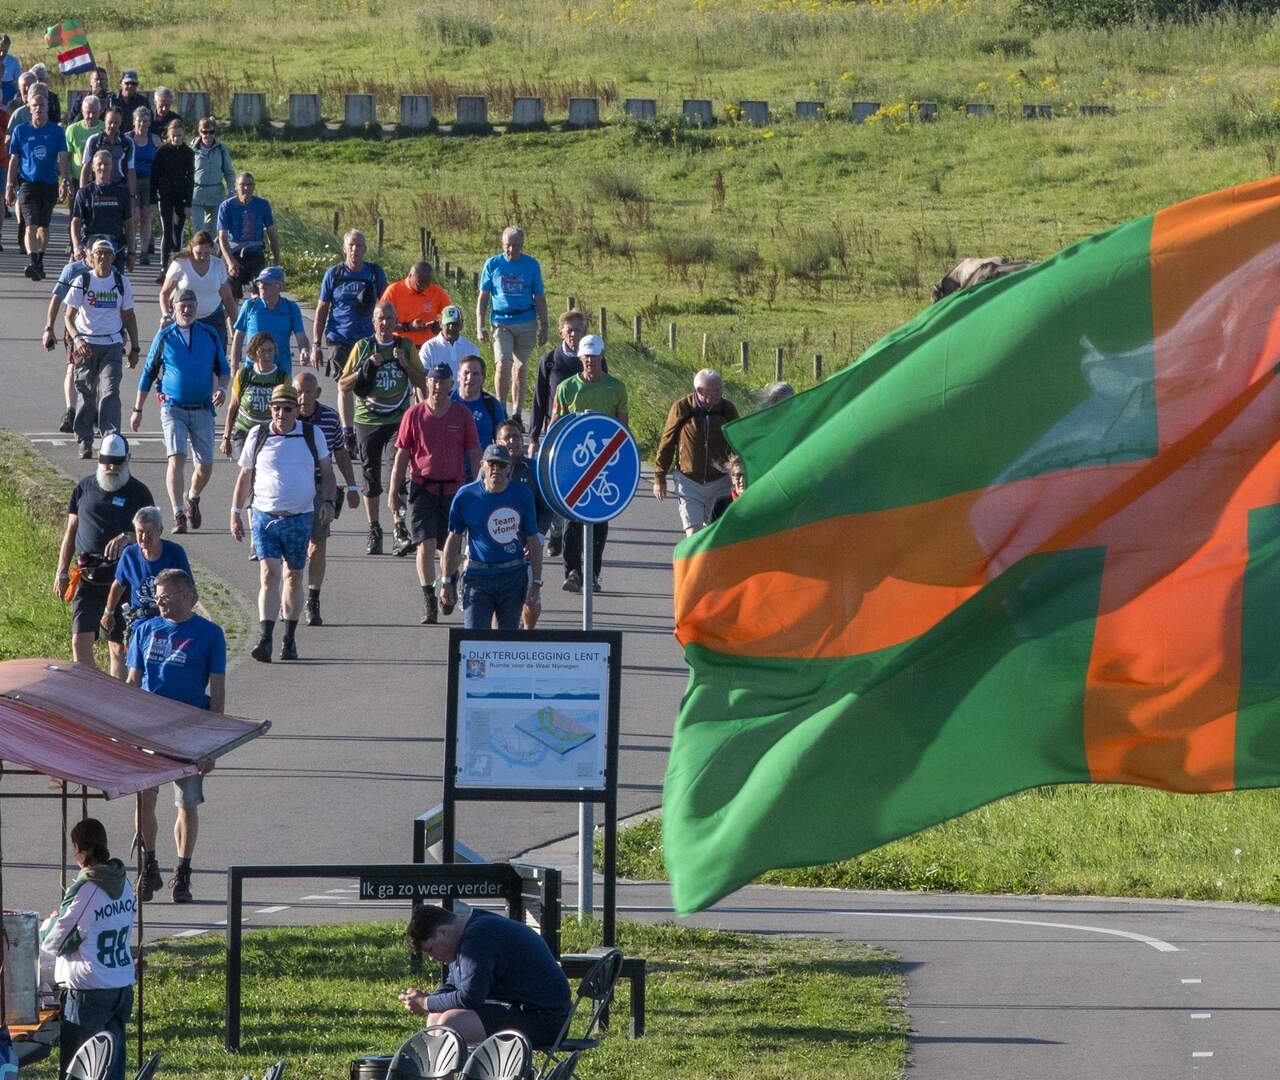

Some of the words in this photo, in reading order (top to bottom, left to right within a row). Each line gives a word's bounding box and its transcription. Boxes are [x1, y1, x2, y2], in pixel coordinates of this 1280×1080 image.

[375, 377, 397, 390] zijn
[493, 516, 516, 527] Team
[468, 650, 571, 661] DIJKTERUGLEGGING
[574, 652, 600, 661] LENT
[362, 881, 375, 896] Ik
[378, 884, 394, 899] ga
[398, 884, 414, 896] zo
[417, 883, 454, 896] weer
[456, 881, 503, 895] verder
[96, 925, 131, 969] 88
